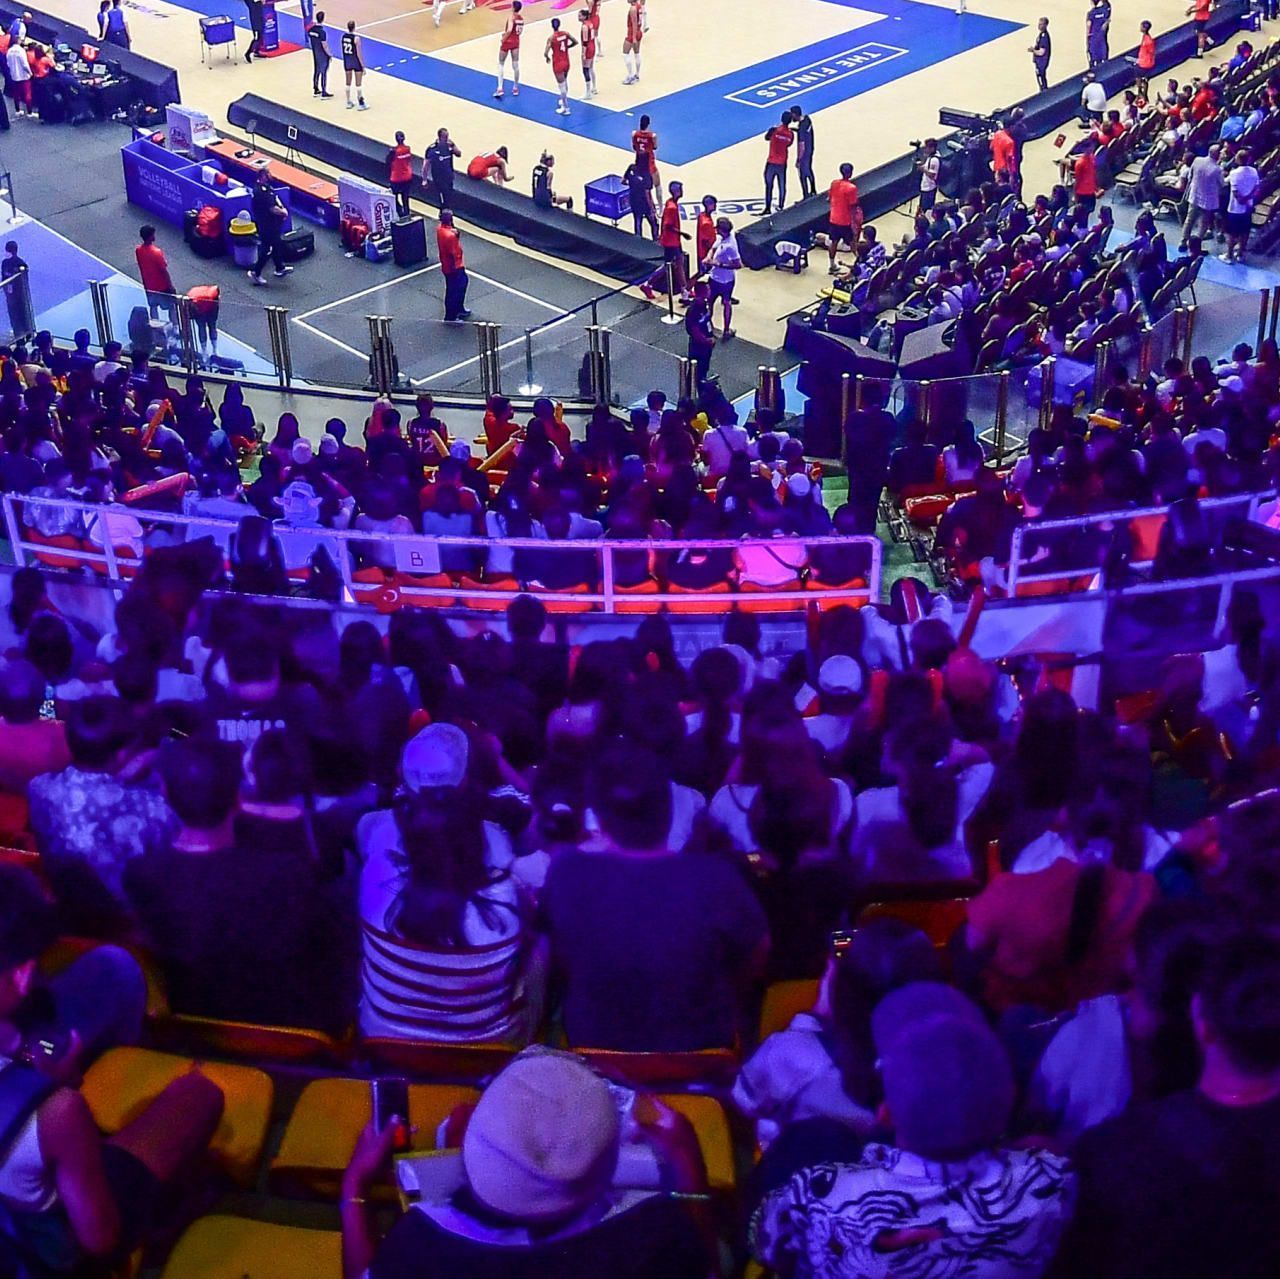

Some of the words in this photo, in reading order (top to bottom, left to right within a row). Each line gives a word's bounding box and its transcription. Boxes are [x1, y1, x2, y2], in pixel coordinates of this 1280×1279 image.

[343, 42, 353, 55] 22
[835, 51, 882, 69] THE
[756, 68, 839, 99] FINALS
[416, 437, 434, 454] 12
[410, 551, 424, 567] B
